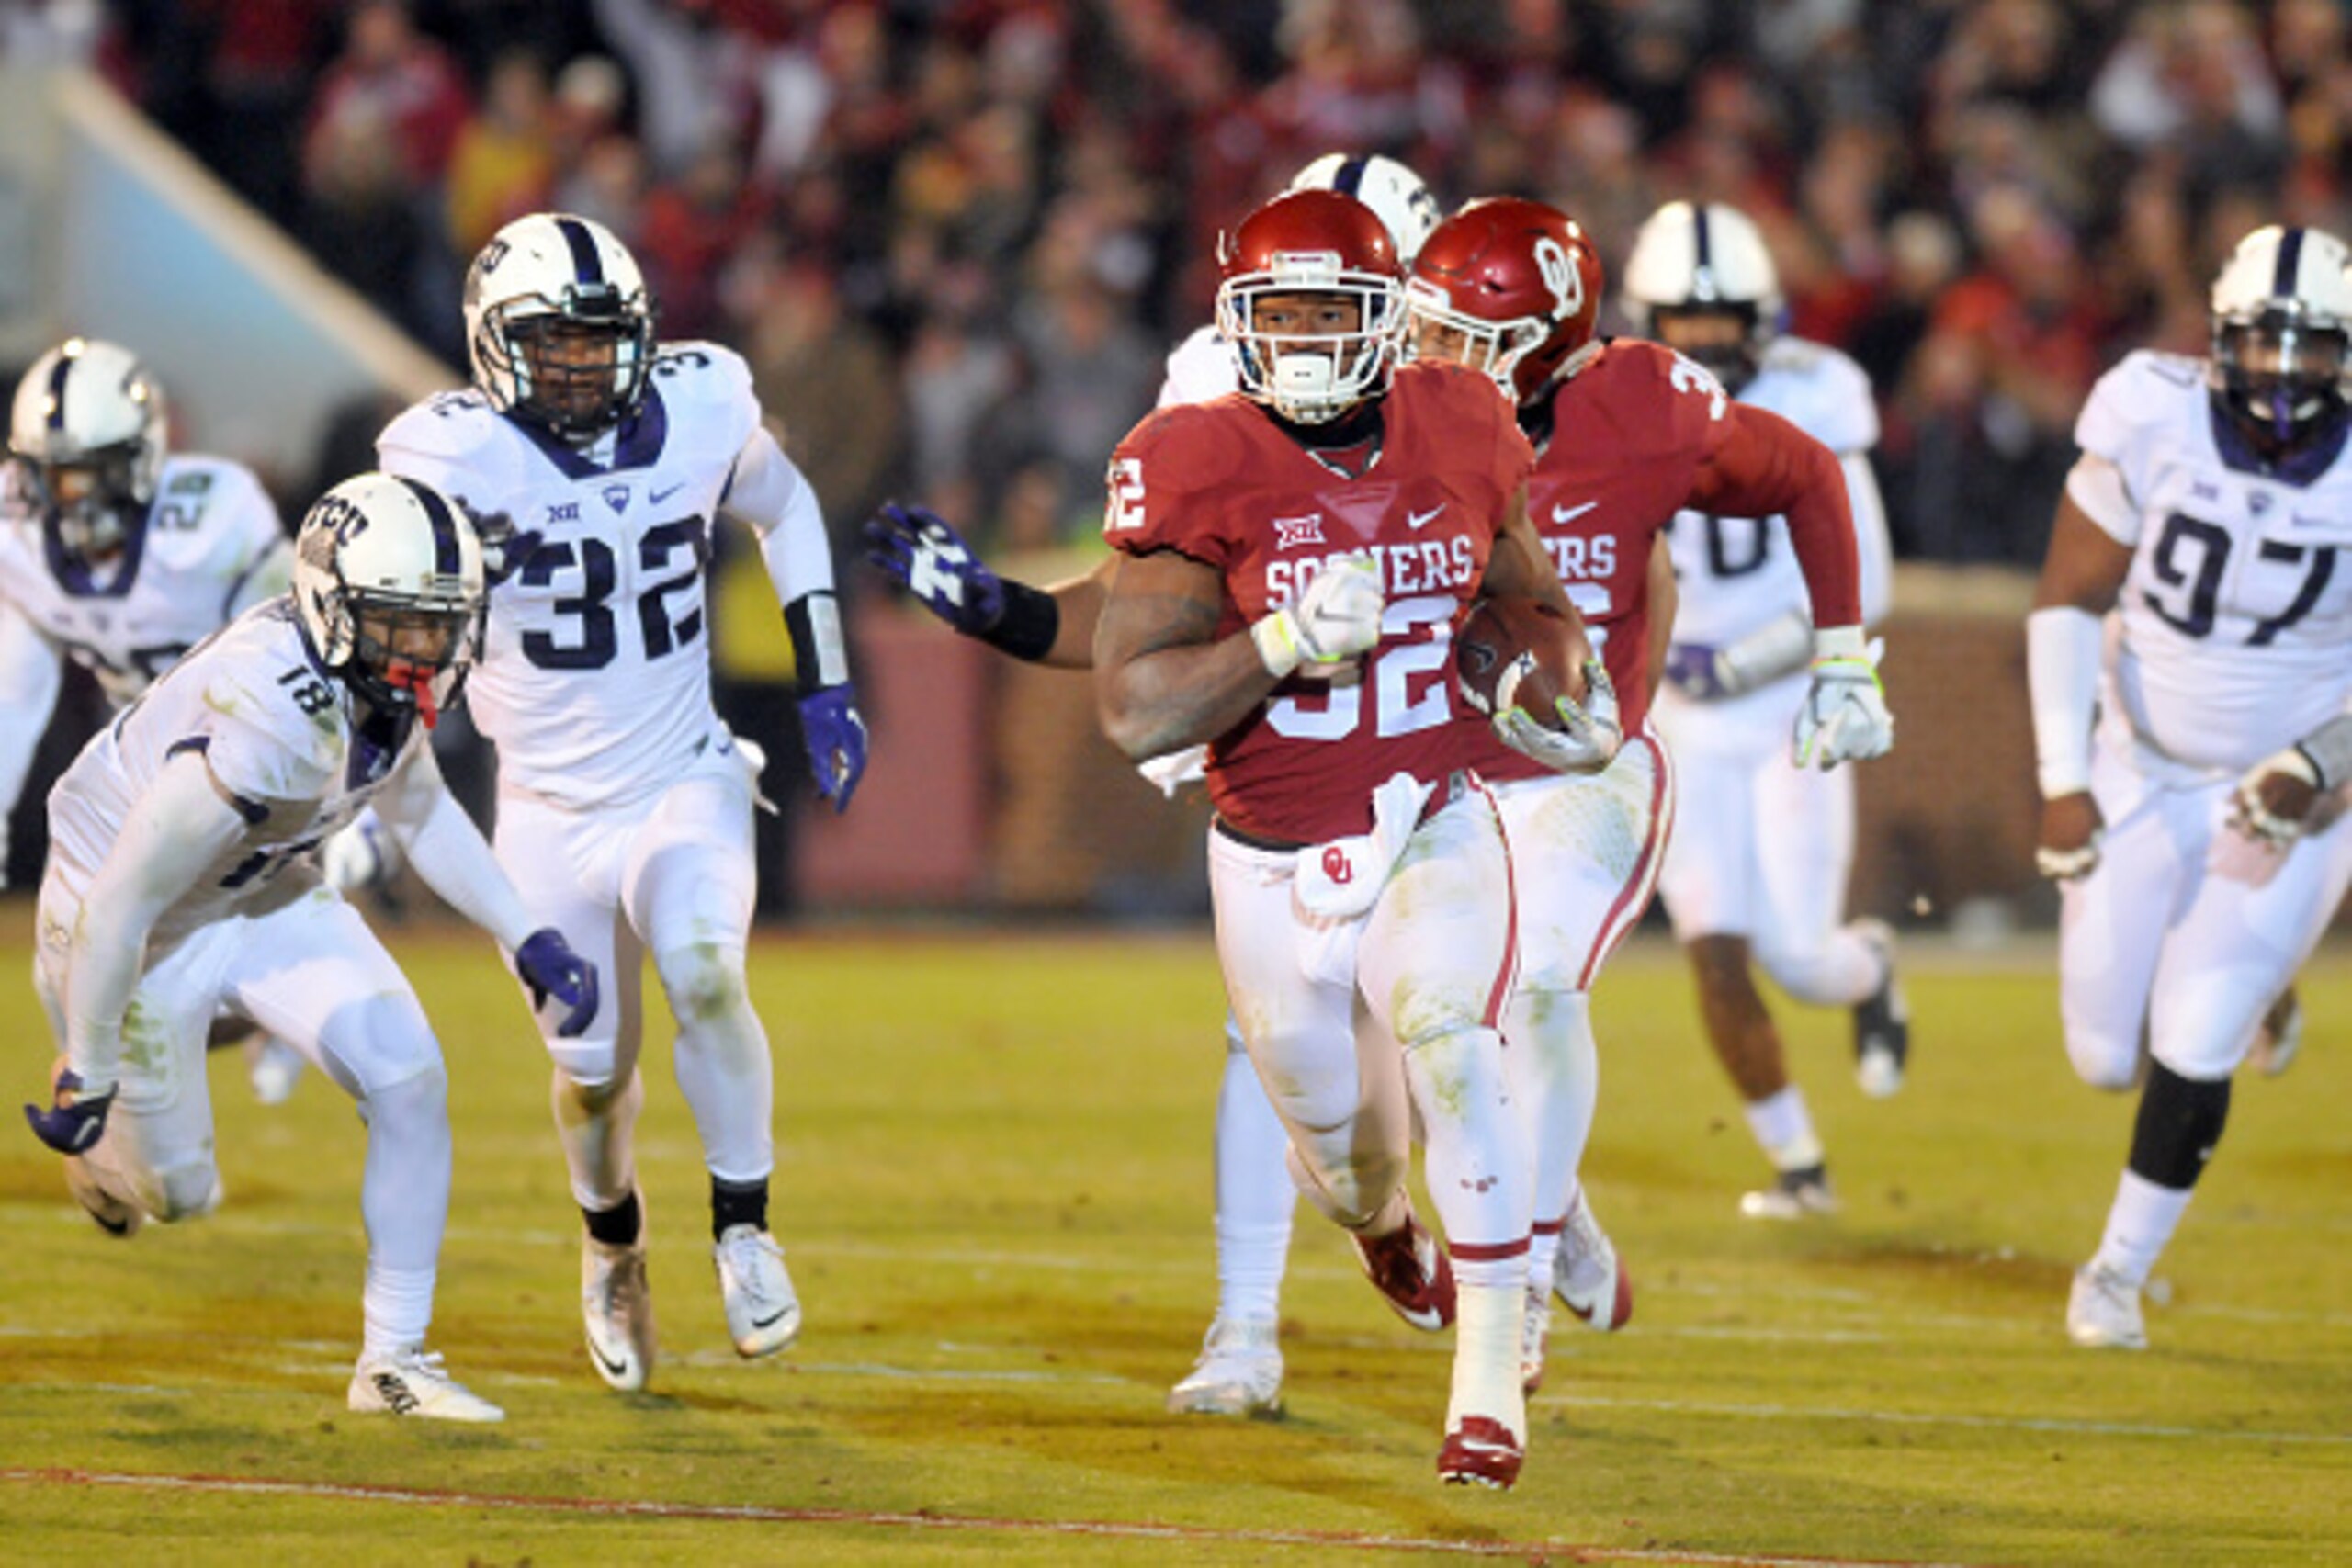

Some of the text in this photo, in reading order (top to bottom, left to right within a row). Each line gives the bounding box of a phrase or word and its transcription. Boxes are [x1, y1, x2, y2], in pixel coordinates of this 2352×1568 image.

[519, 514, 706, 671] 32
[1266, 534, 1474, 611] SOERS
[2142, 511, 2338, 647] 97
[277, 664, 335, 716] 18
[1322, 846, 1352, 885] OU
